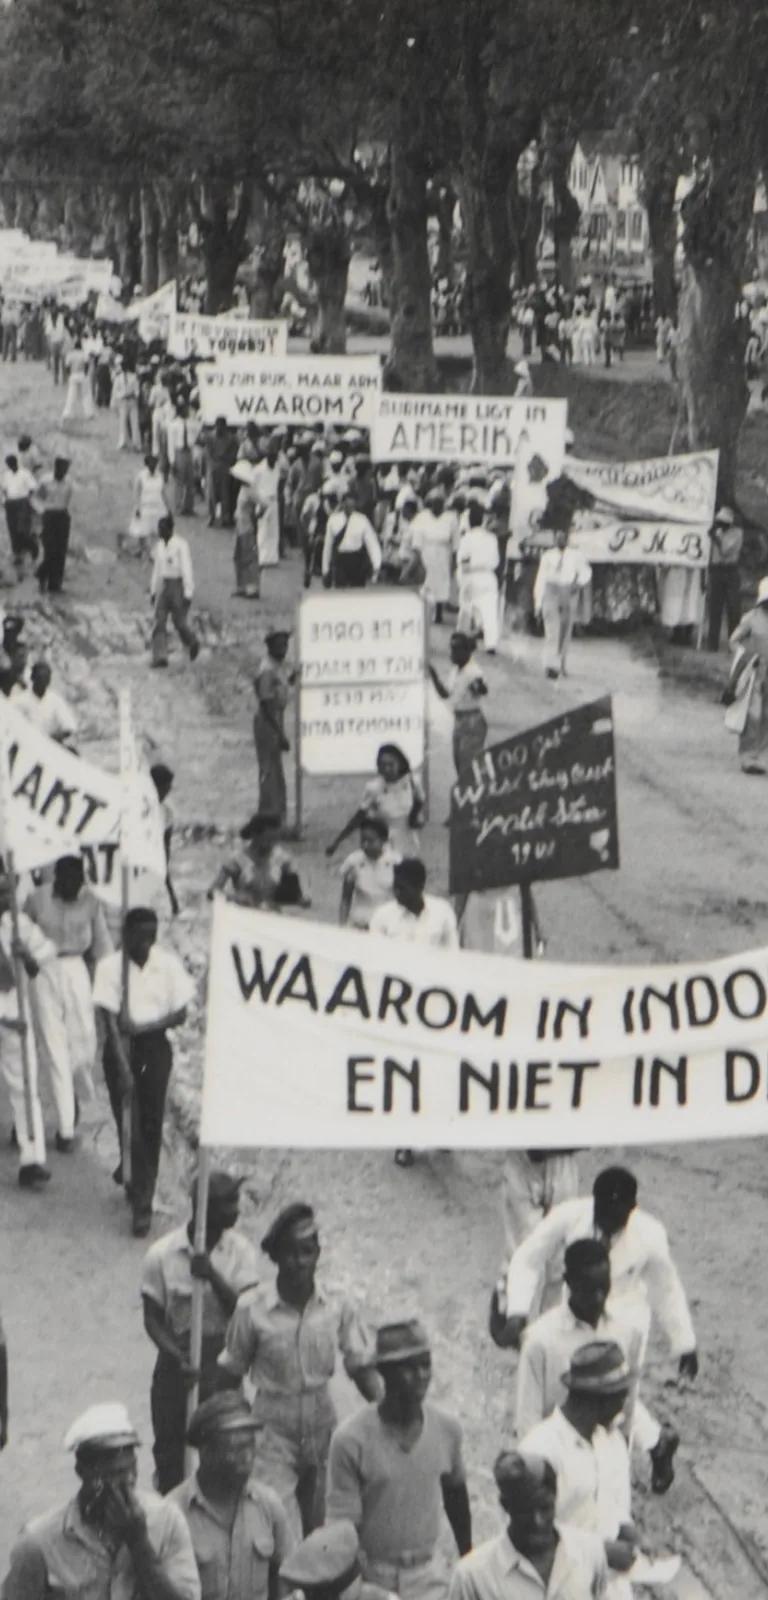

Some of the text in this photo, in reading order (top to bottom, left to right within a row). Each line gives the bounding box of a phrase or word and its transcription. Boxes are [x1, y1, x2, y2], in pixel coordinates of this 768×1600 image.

[298, 374, 342, 387] MAAR
[348, 374, 378, 389] ARM
[476, 403, 513, 420] LIGT
[526, 405, 546, 421] IN
[231, 944, 768, 1040] WAAROM IN INDO
[346, 1049, 768, 1114] EN NIET IN D
